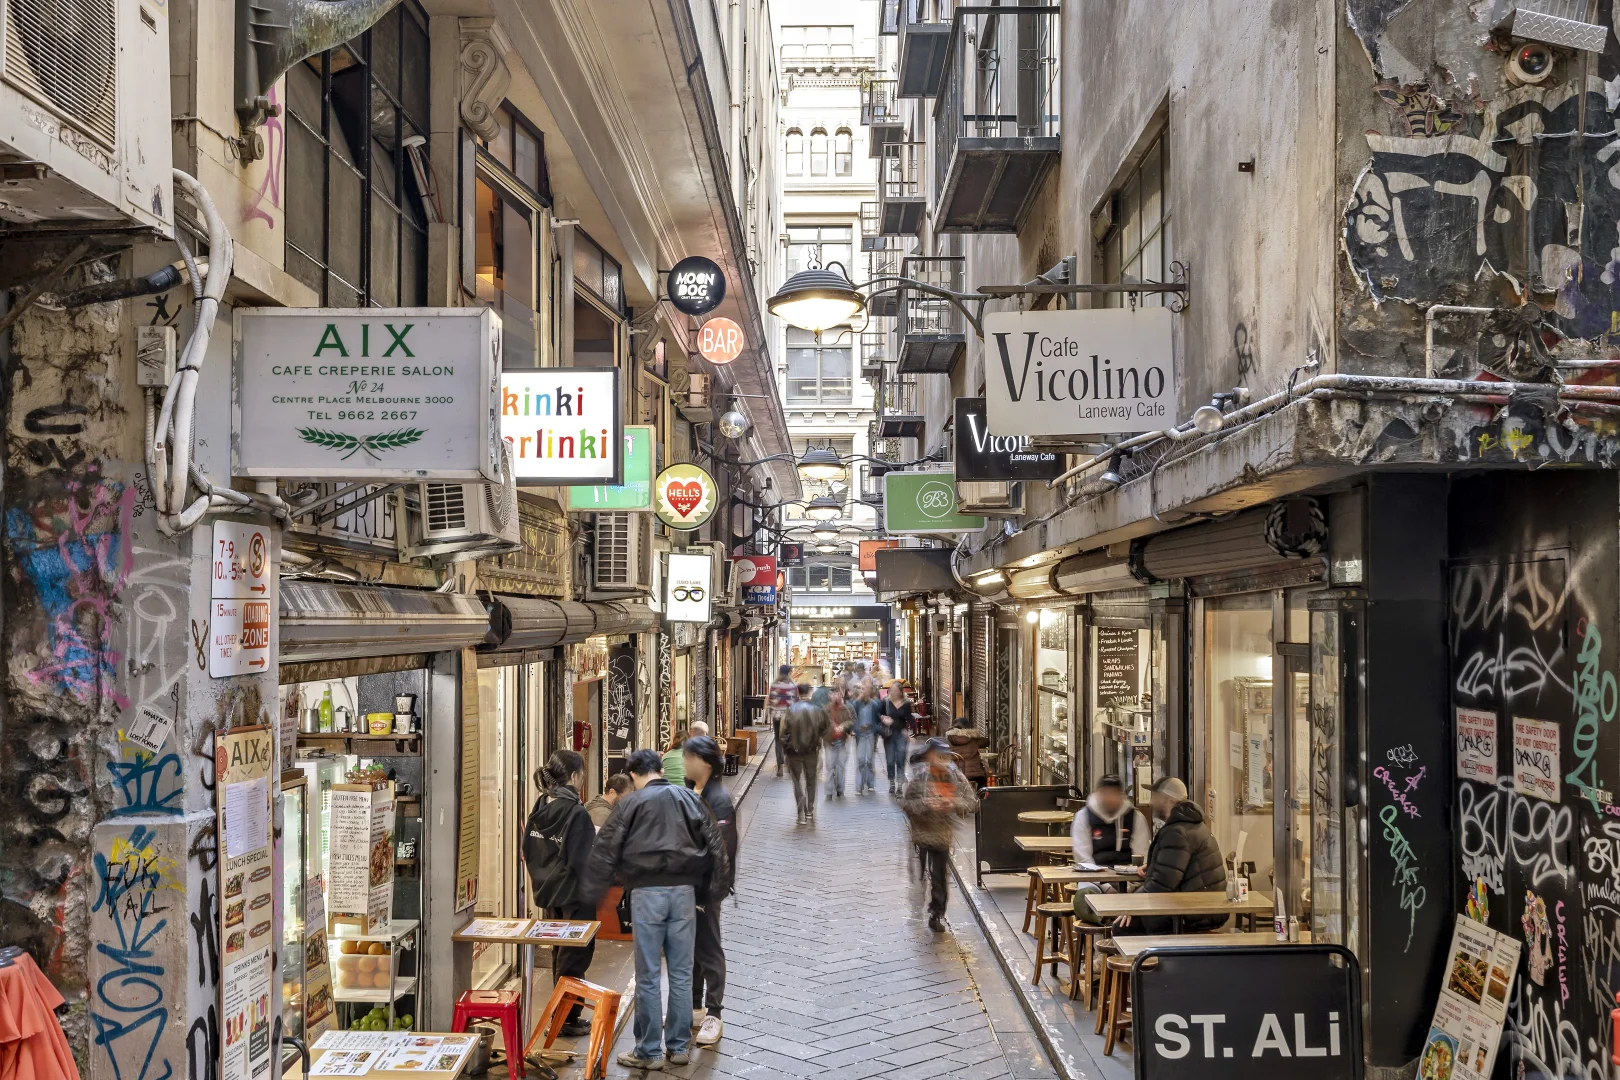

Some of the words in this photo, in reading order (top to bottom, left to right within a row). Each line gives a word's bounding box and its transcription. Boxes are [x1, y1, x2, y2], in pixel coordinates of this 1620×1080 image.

[676, 272, 716, 285] MOON
[678, 284, 708, 297] DOG
[312, 324, 416, 357] AIX
[703, 328, 738, 354] BAR
[1040, 336, 1079, 358] Cafe
[272, 366, 313, 376] CAFE
[319, 366, 396, 376] CREPERIE
[402, 366, 454, 376] SALON
[992, 331, 1165, 402] Vicolino
[370, 382, 385, 393] 24
[425, 396, 454, 404] 3000
[502, 386, 583, 416] kinki
[338, 411, 375, 420] 9662
[381, 411, 418, 420] 2667
[1078, 404, 1132, 421] Laneway
[1137, 402, 1165, 417] Cafe
[503, 429, 608, 459] rlinki
[1010, 453, 1038, 463] Laneway
[1041, 453, 1056, 462] Cafe
[669, 488, 700, 498] HELL'S
[756, 563, 771, 571] rush
[244, 605, 268, 623] LOADING
[243, 628, 268, 647] ZONE
[143, 709, 159, 721] WHAT
[1459, 714, 1467, 723] FIRE
[1467, 716, 1482, 725] SAFETY
[1482, 717, 1494, 727] DOOR
[1459, 726, 1466, 734] DO
[1465, 727, 1473, 735] NOT
[1473, 729, 1494, 739] OBSTRUCT
[1515, 724, 1525, 733] FIRE
[1525, 725, 1543, 736] SAFETY
[1543, 729, 1557, 739] DOOR
[129, 732, 142, 741] LOST
[141, 738, 159, 750] FORM?
[1515, 736, 1522, 745] DO
[1523, 738, 1531, 747] NOT
[231, 738, 261, 767] AIX
[1461, 760, 1467, 768] NO
[1476, 763, 1493, 775] POSTERS
[1518, 774, 1524, 783] NO
[1535, 778, 1555, 791] POSTERS
[226, 856, 246, 872] LUNCH
[246, 849, 268, 865] SPECIAL
[233, 958, 250, 974] DRINKS
[250, 952, 262, 965] MENU
[1154, 1013, 1234, 1059] ST.
[1251, 1011, 1341, 1058] ALi
